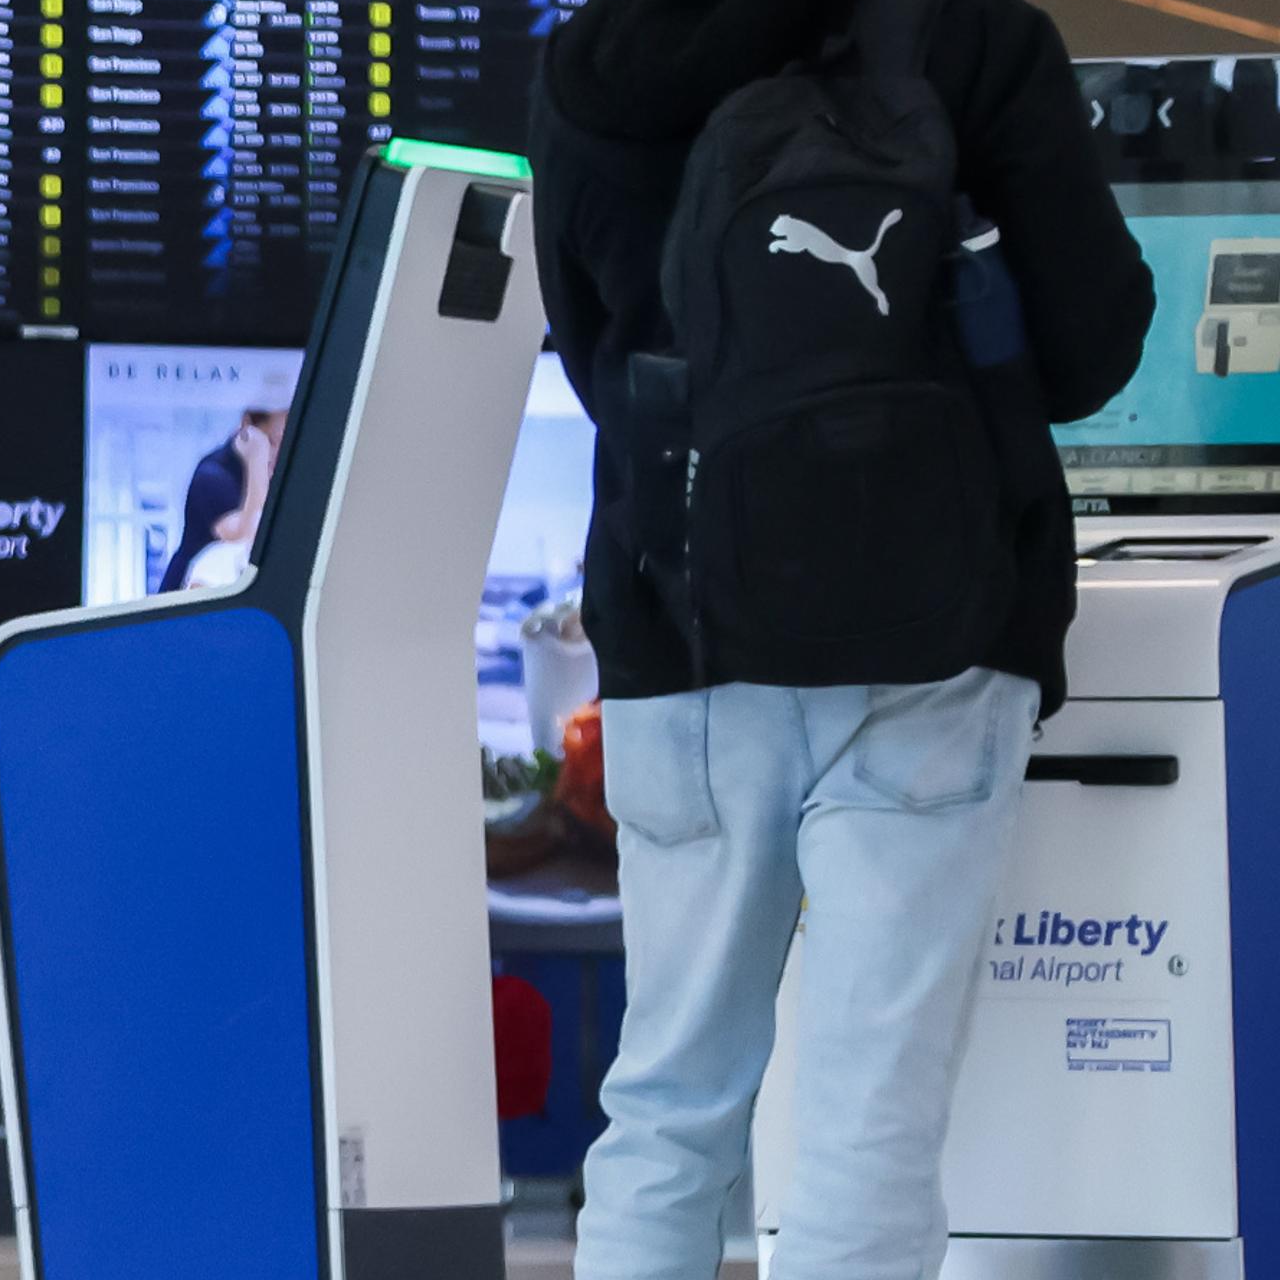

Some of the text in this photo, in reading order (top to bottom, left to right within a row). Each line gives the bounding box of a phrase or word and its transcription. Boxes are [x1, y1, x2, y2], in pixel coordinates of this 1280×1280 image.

[108, 362, 243, 381] BE RELAX
[1013, 910, 1168, 956] Liberty
[1029, 956, 1125, 987] Airport
